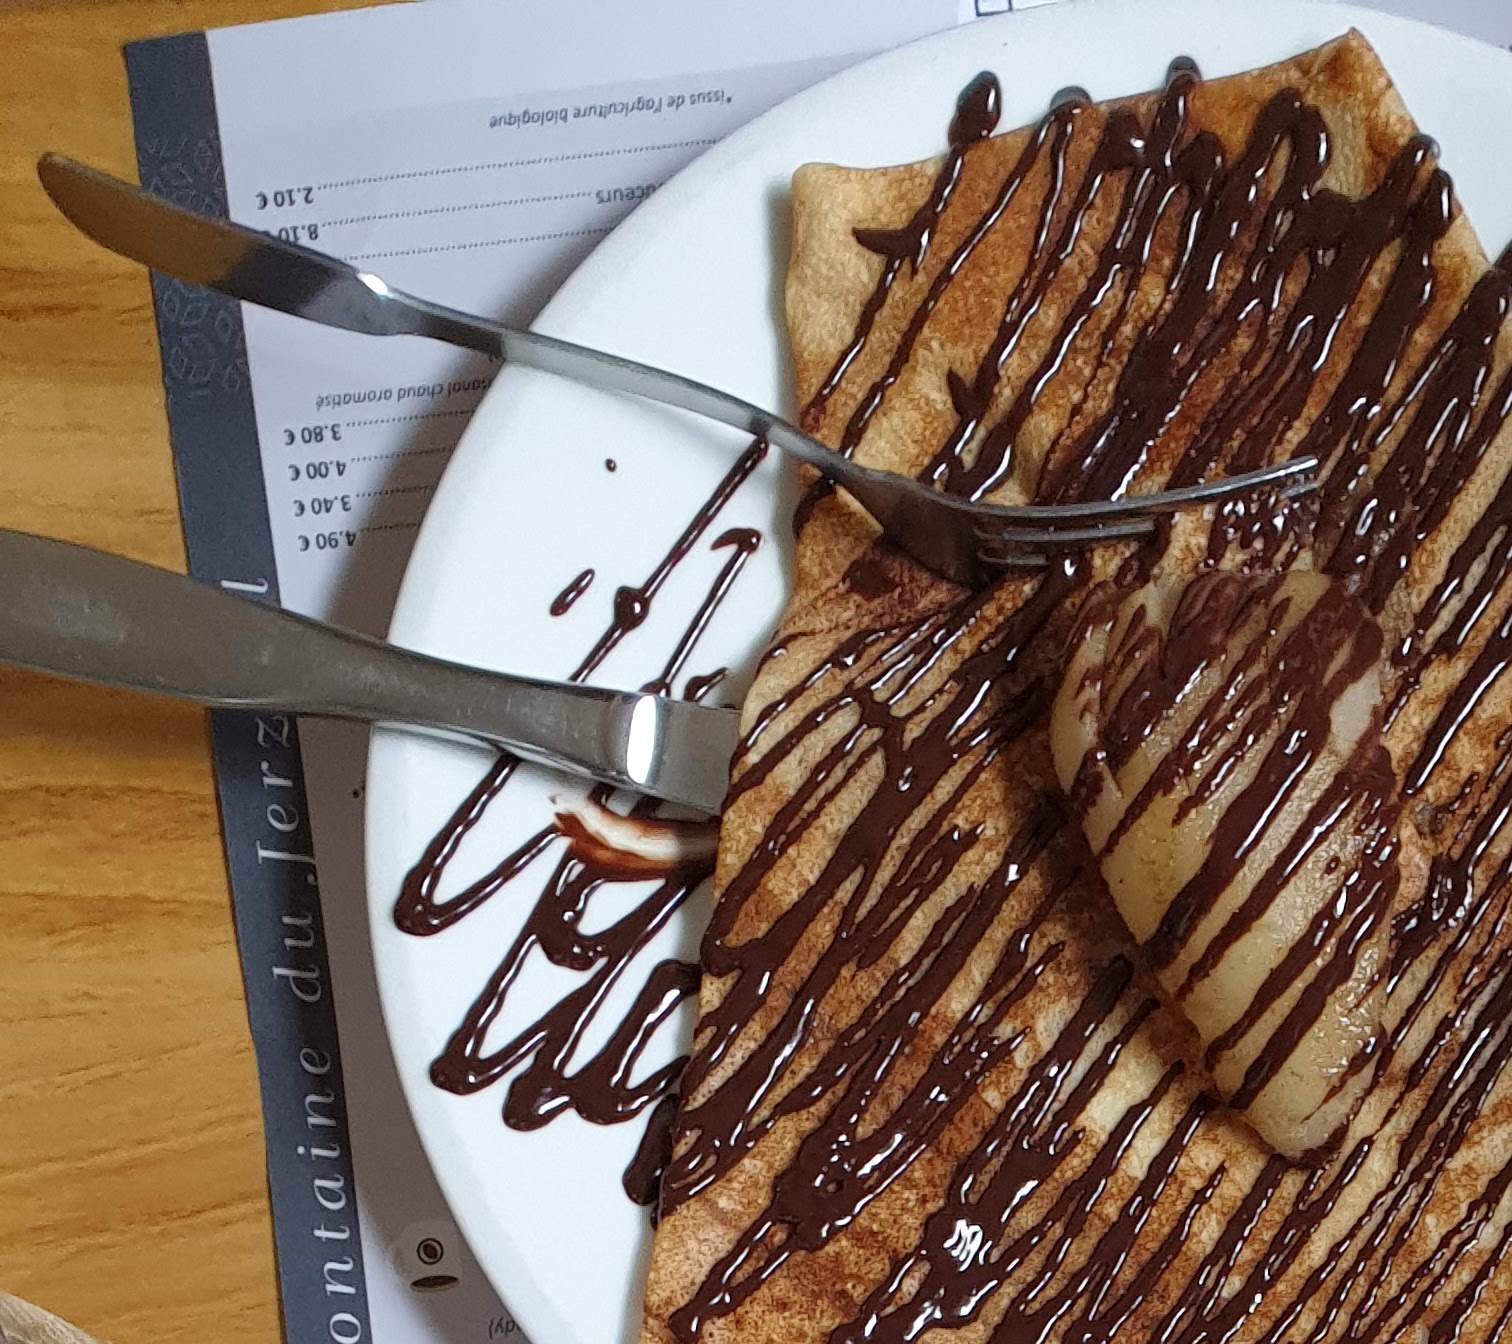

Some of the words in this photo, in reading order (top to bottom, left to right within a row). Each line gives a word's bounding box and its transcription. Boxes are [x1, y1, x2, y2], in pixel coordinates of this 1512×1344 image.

[666, 94, 686, 111] de
[489, 107, 569, 129] biologique
[256, 192, 268, 210] €
[273, 186, 314, 208] 2.10
[283, 429, 296, 446] €
[300, 423, 342, 444] 3.80
[272, 911, 322, 1004] du
